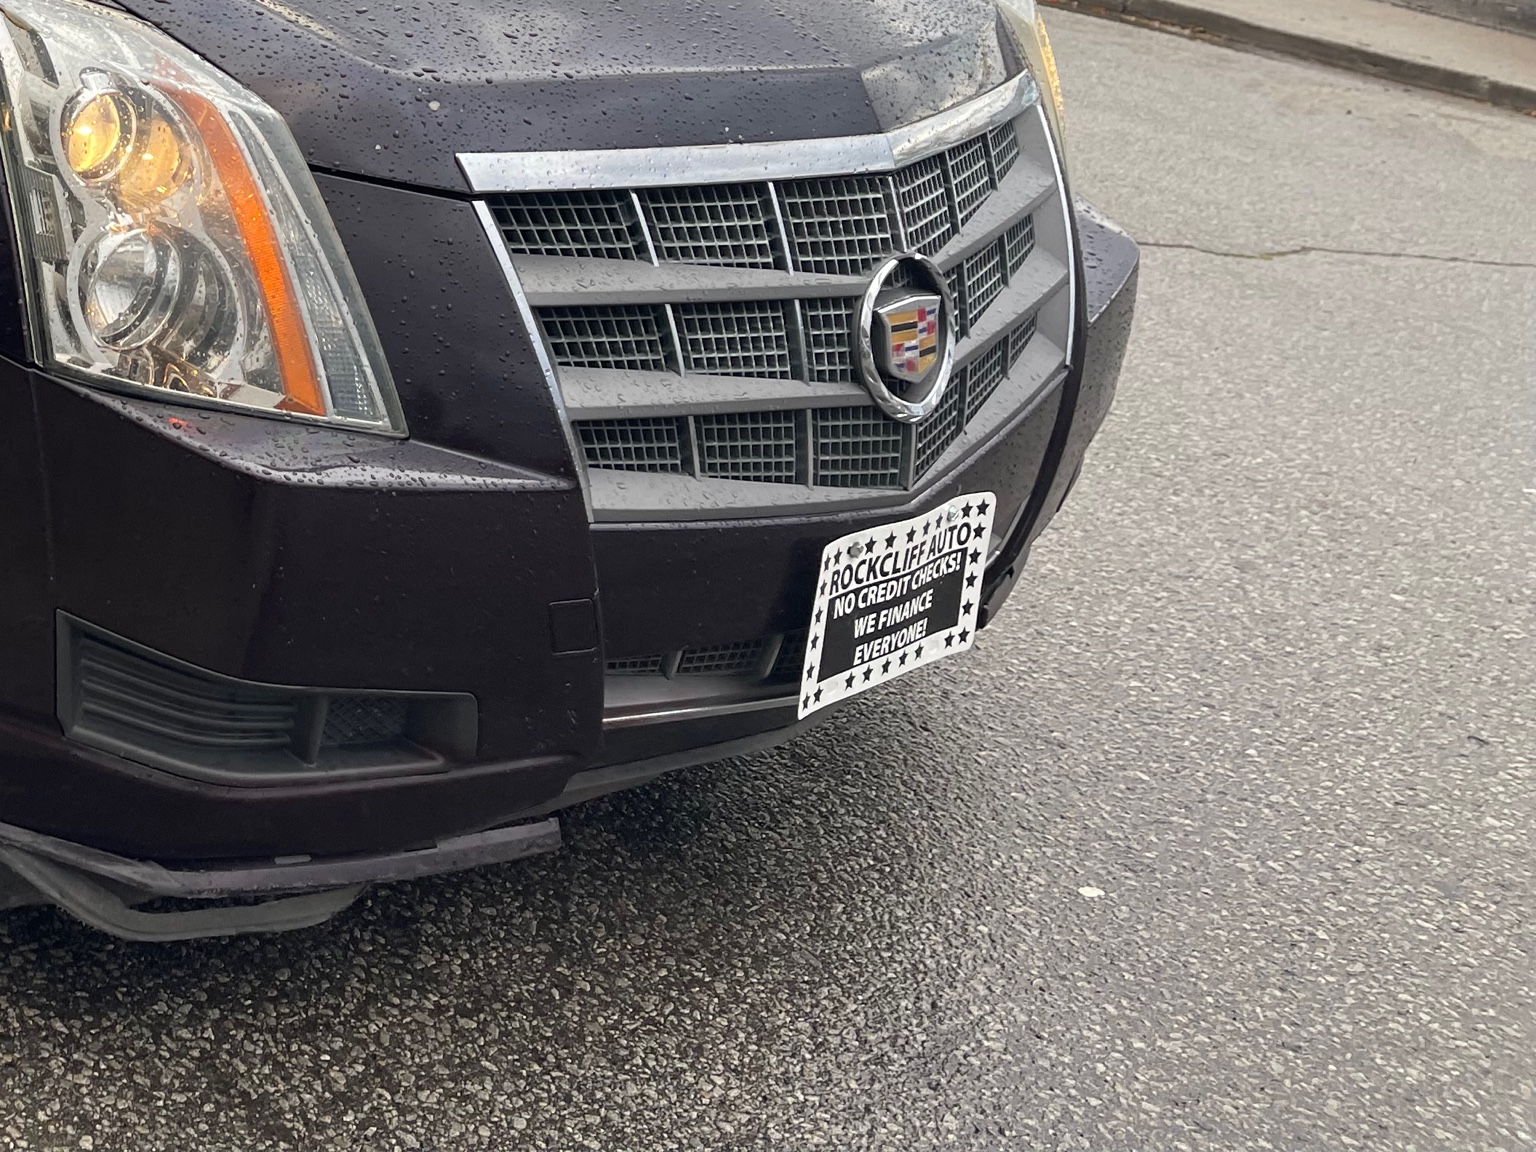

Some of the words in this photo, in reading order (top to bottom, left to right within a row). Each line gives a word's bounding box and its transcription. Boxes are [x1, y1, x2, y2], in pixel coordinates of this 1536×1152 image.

[829, 538, 927, 596] ROCKCLIFF
[927, 522, 972, 561] AUTO
[833, 593, 855, 619] NO
[858, 575, 910, 609] CREDIT
[911, 552, 962, 591] CHECKS!
[853, 618, 928, 666] EVERYONE!
[854, 612, 876, 638] WE
[878, 589, 934, 630] FINANCE
